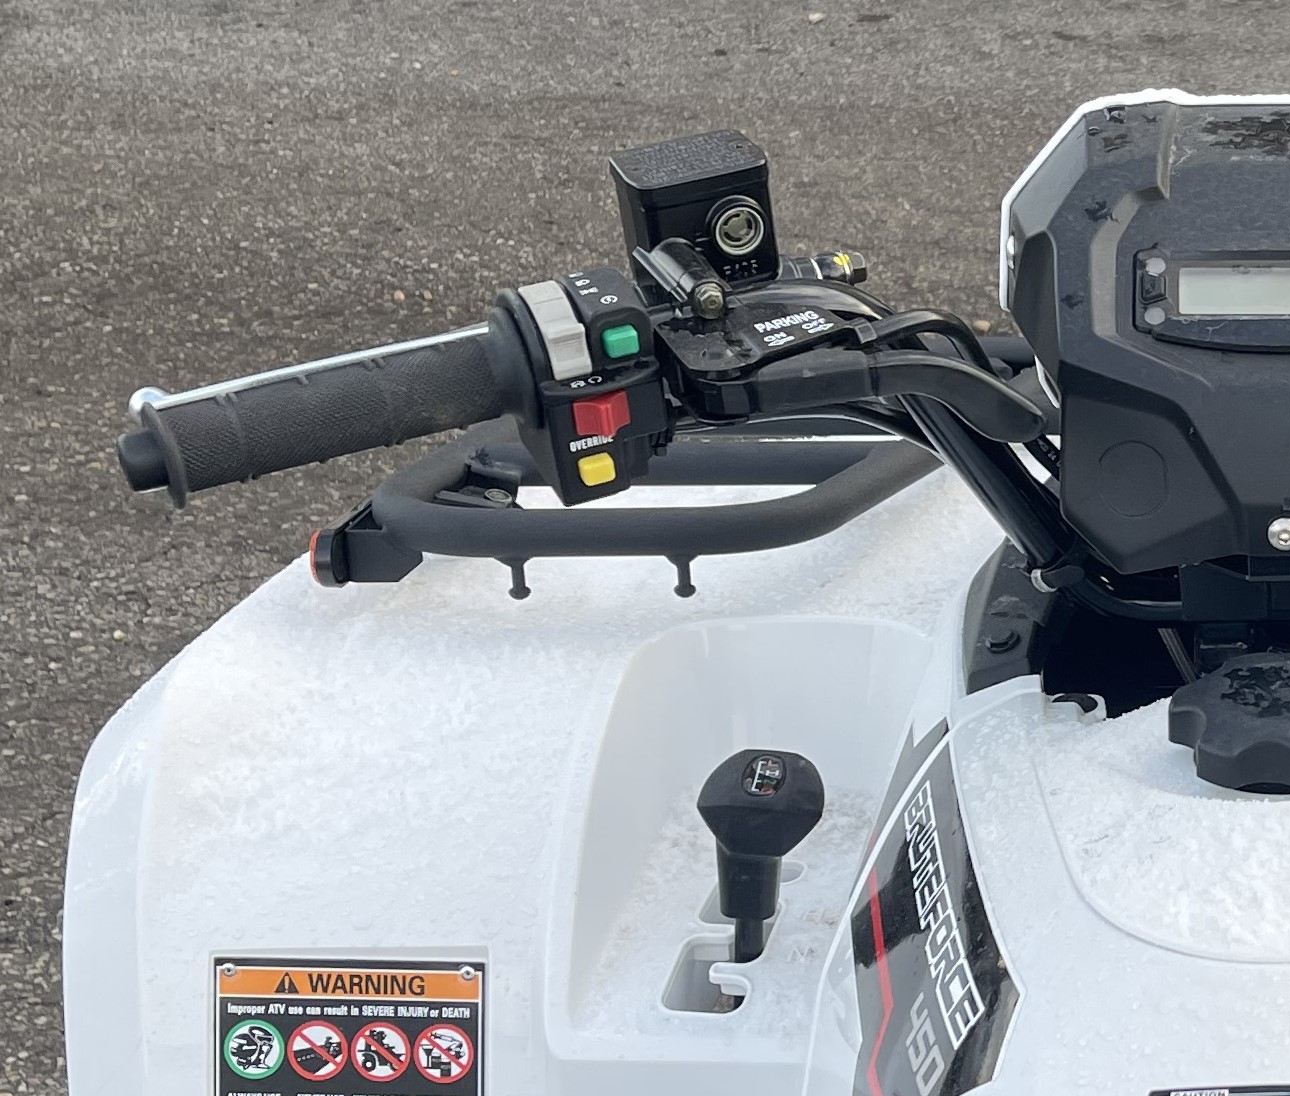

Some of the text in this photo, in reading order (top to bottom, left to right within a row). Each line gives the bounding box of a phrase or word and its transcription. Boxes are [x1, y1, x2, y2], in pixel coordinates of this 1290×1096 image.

[754, 311, 819, 333] PARKING
[802, 318, 825, 329] OFF
[764, 332, 786, 342] ON
[308, 974, 425, 995] WARNING
[228, 1003, 470, 1018] Improper ATV use can result in SEVERE INJURY or DEATH
